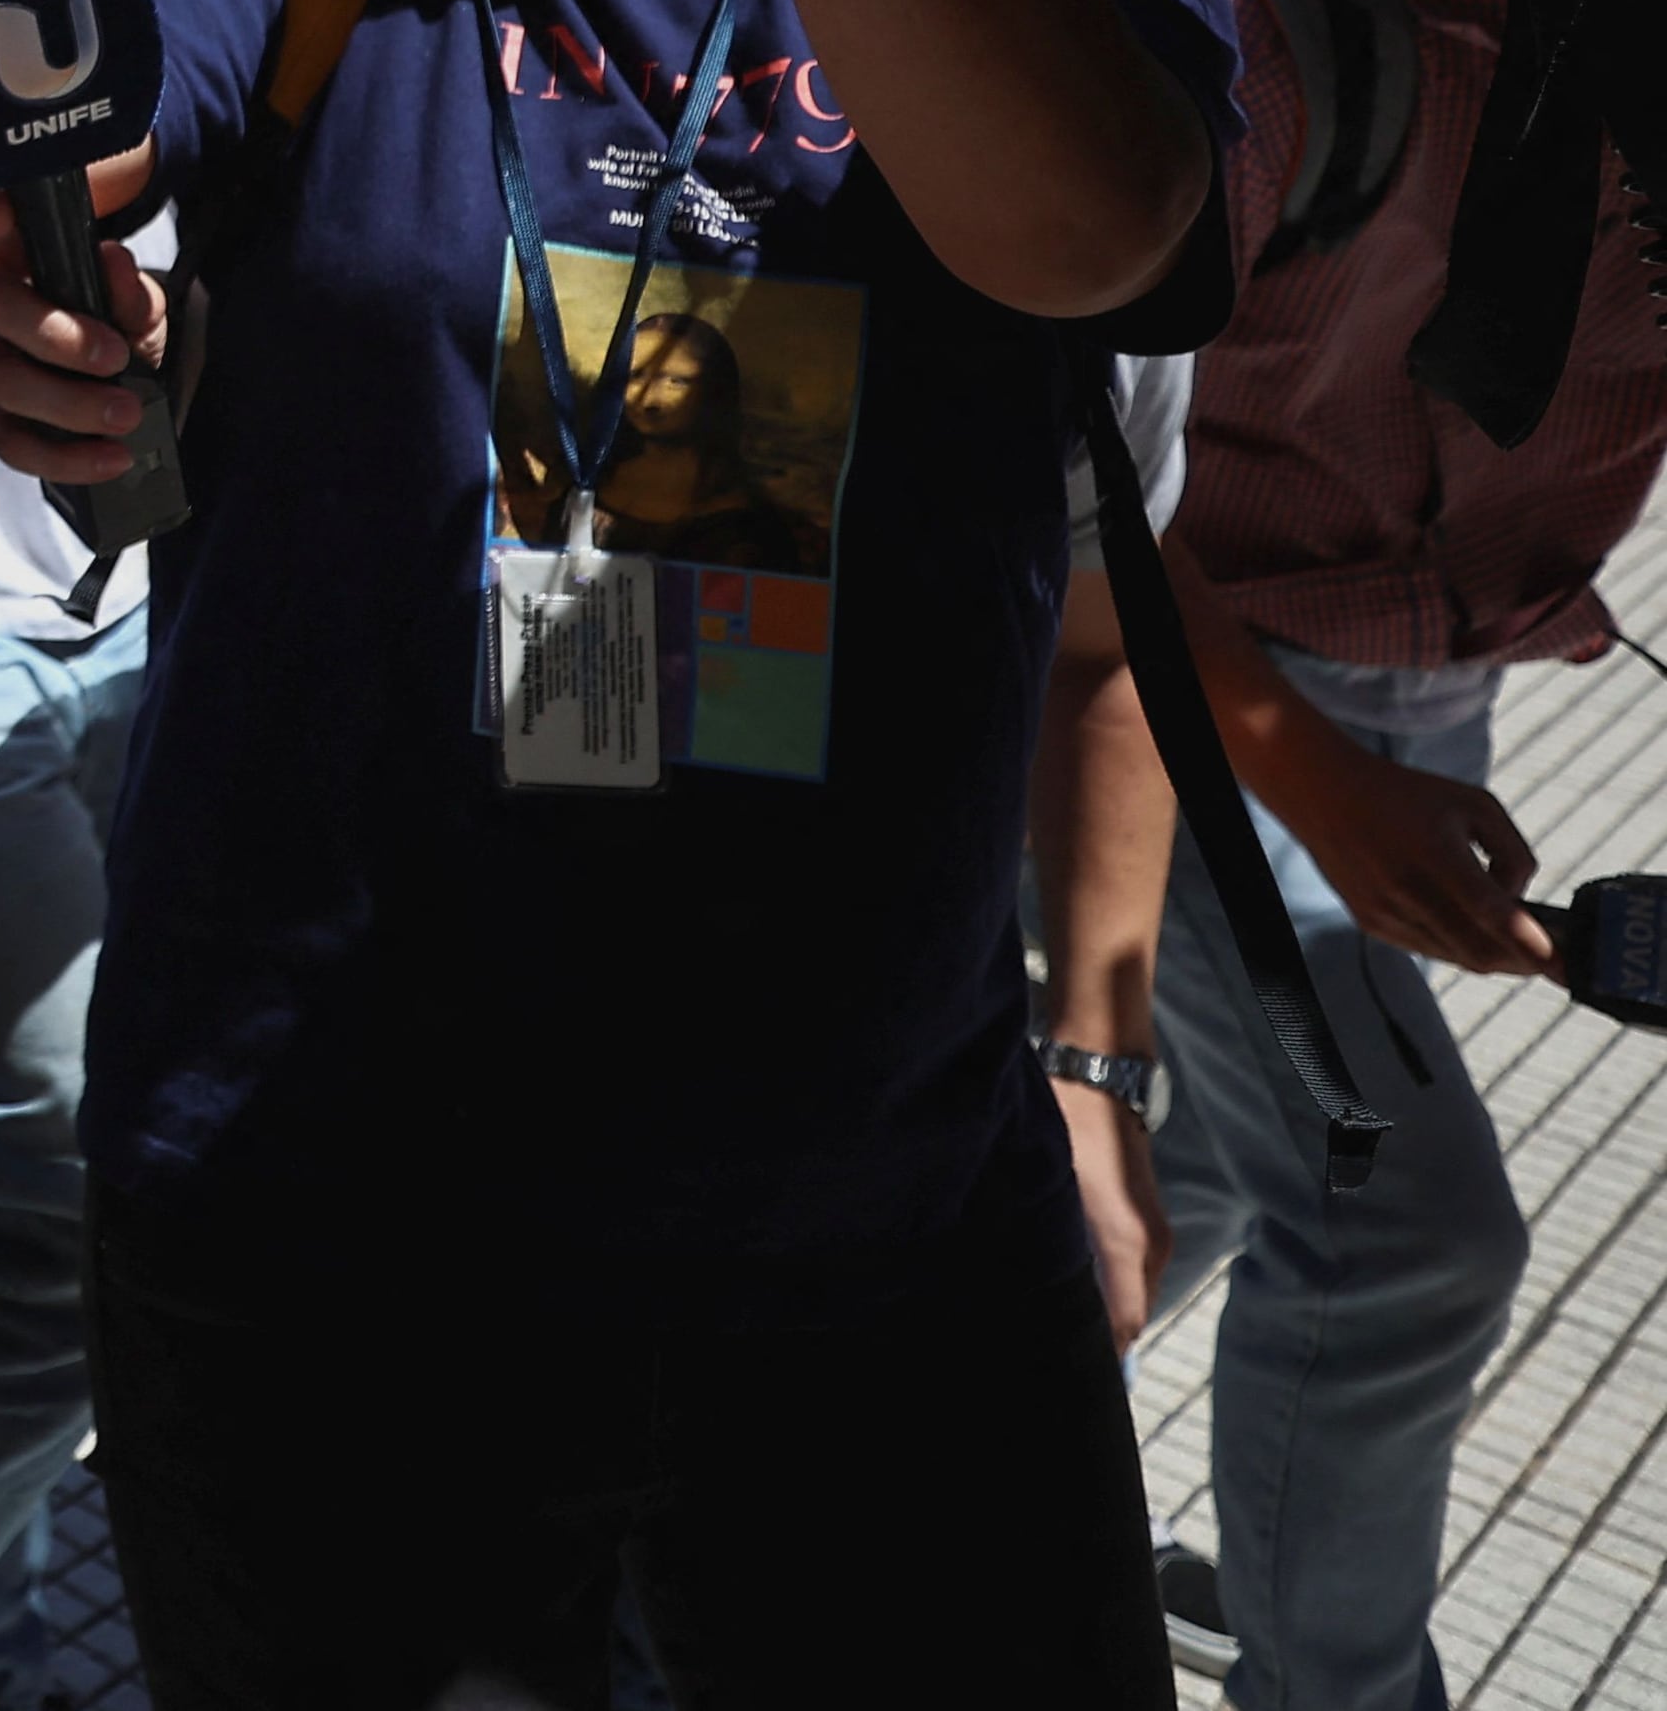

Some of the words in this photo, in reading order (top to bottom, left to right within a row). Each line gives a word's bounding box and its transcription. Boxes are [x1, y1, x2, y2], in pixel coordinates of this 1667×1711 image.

[5, 96, 114, 146] UNIFE
[605, 144, 658, 164] Portrait
[587, 157, 618, 174] wife
[618, 162, 635, 177] of
